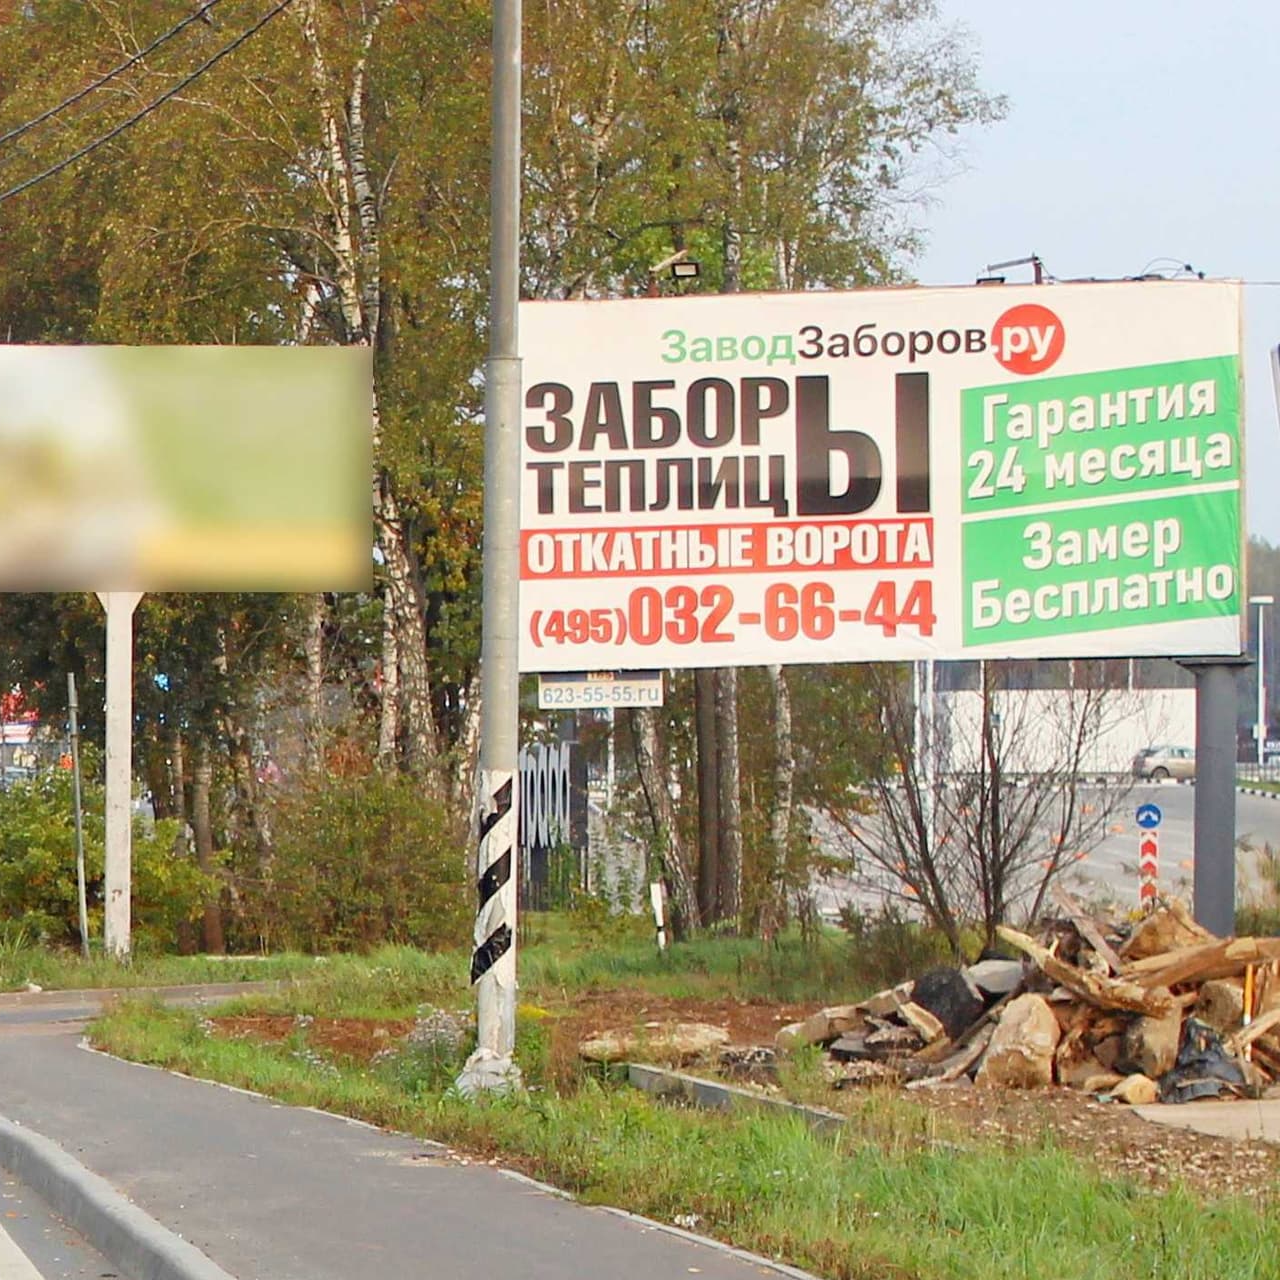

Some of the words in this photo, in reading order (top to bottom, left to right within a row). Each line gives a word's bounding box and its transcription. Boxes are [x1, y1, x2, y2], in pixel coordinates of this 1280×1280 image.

[983, 380, 1217, 449] Гарантия
[967, 447, 1027, 500] 24
[1045, 432, 1233, 490] месяца
[526, 527, 754, 575] ОТКАТНЫЕ
[765, 522, 932, 567] ВОРОТА
[1022, 516, 1182, 572] Замер
[971, 563, 1234, 629] Бесплатно
[542, 685, 659, 704] 623-55-55.ru
